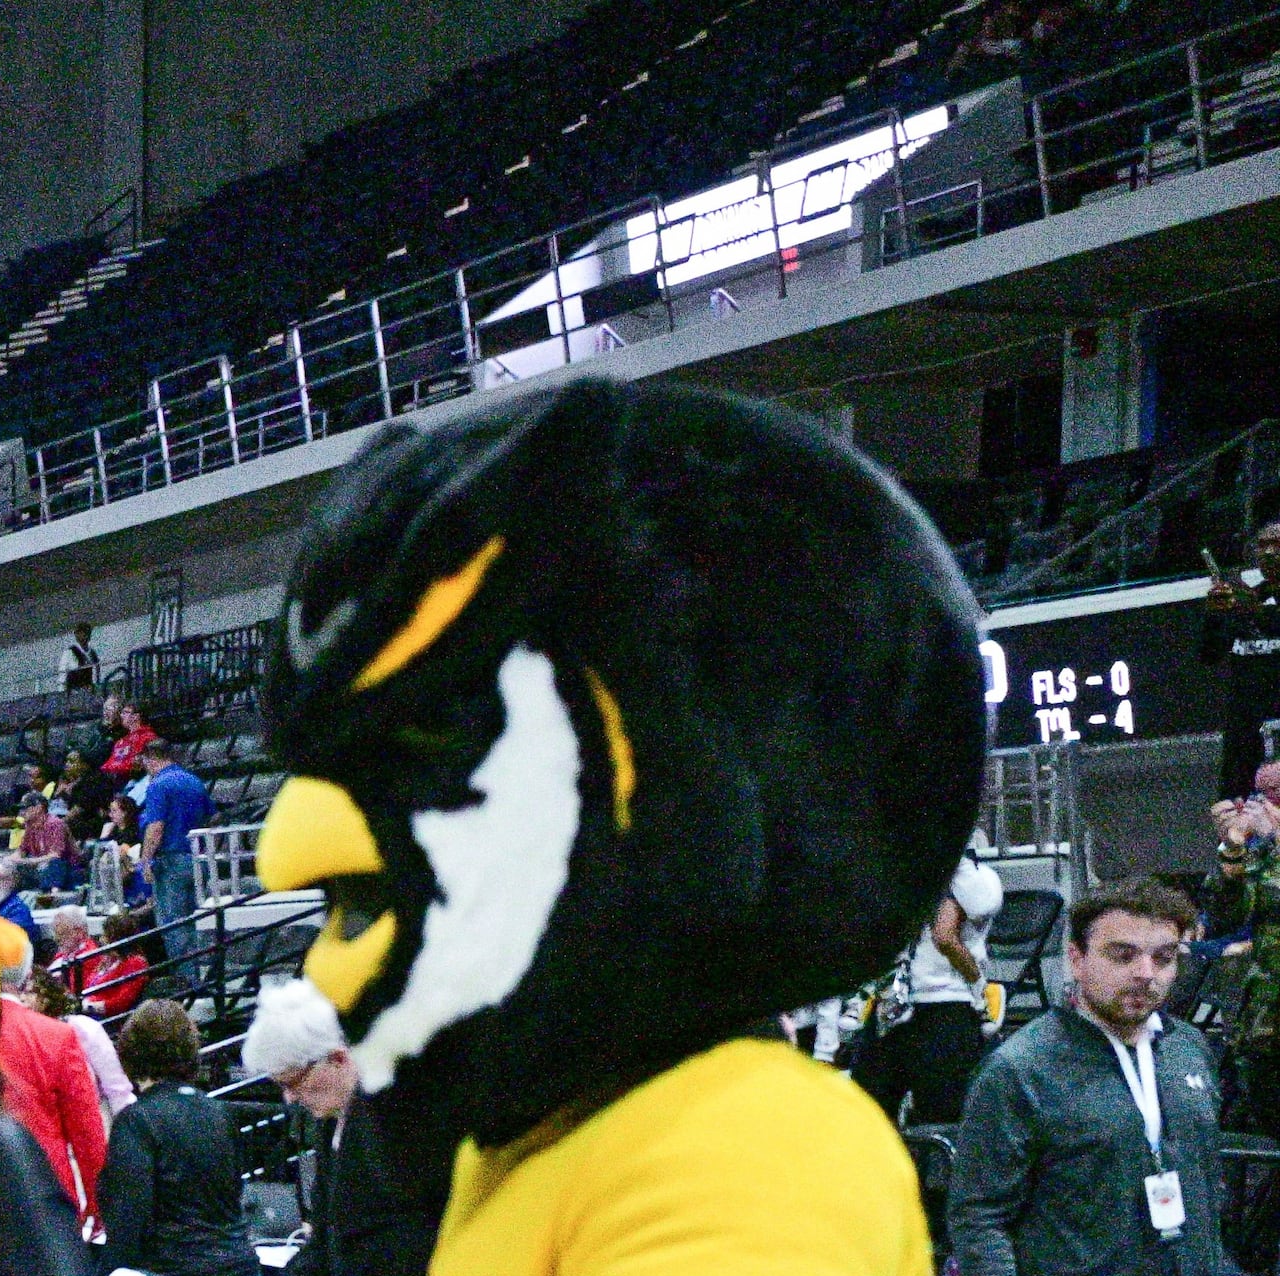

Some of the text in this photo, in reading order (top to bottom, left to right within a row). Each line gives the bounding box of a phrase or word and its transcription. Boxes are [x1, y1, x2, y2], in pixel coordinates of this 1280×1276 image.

[1031, 667, 1078, 705] FLS
[1110, 660, 1131, 696] 0
[1114, 699, 1134, 734] 4
